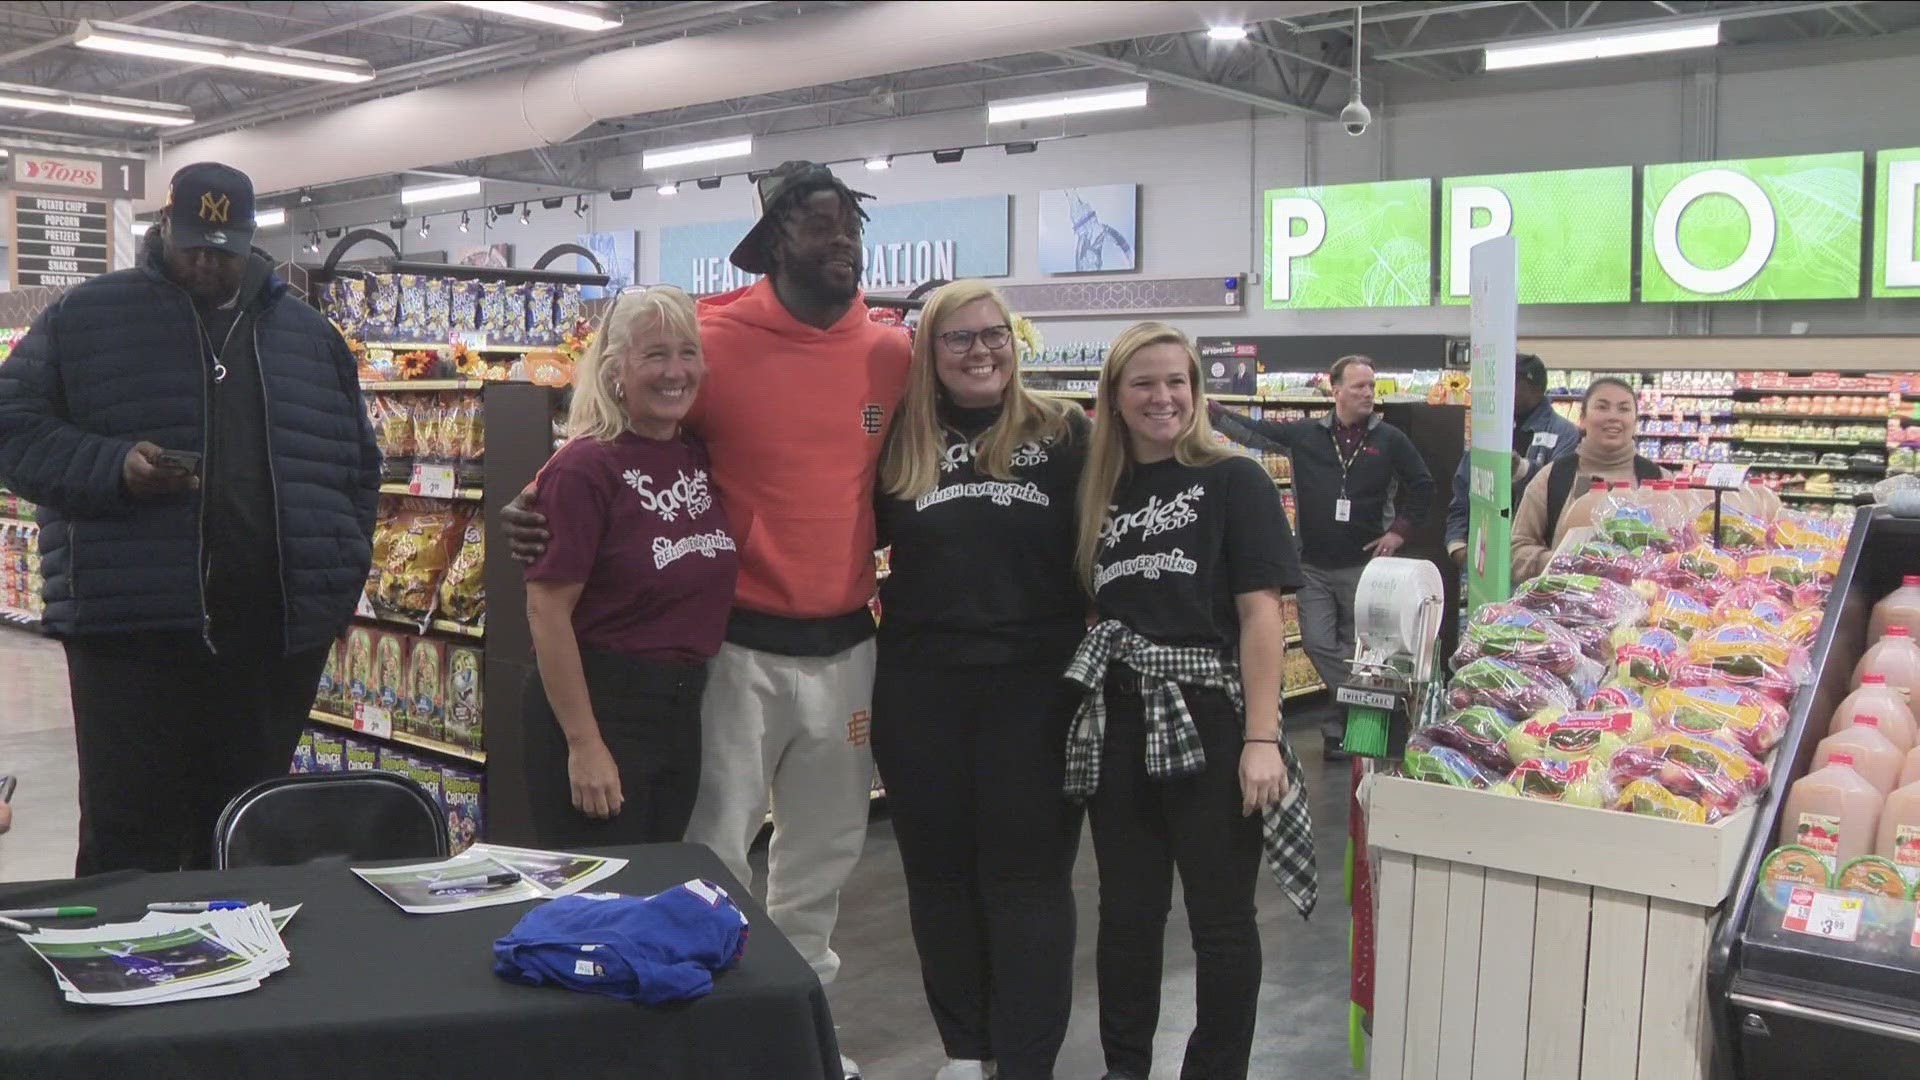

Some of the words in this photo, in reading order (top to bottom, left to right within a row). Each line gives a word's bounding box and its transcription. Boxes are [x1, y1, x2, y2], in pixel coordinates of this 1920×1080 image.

[120, 165, 129, 191] 1
[37, 199, 64, 211] POTATO
[65, 201, 87, 213] CHIPS
[199, 191, 230, 223] NY
[45, 214, 80, 227] POPCORN
[45, 229, 80, 241] PRETZELS
[1271, 197, 1327, 300] P
[1653, 169, 1775, 294] O
[50, 245, 76, 256] CANDY
[48, 260, 78, 271] SNACKS
[40, 275, 65, 286] SNACK
[917, 484, 964, 511] RELISH
[965, 481, 1049, 506] EVERYTHING
[1142, 509, 1198, 541] FOODS
[1122, 553, 1198, 575] EVERYTHING
[446, 790, 478, 806] CRUNCH
